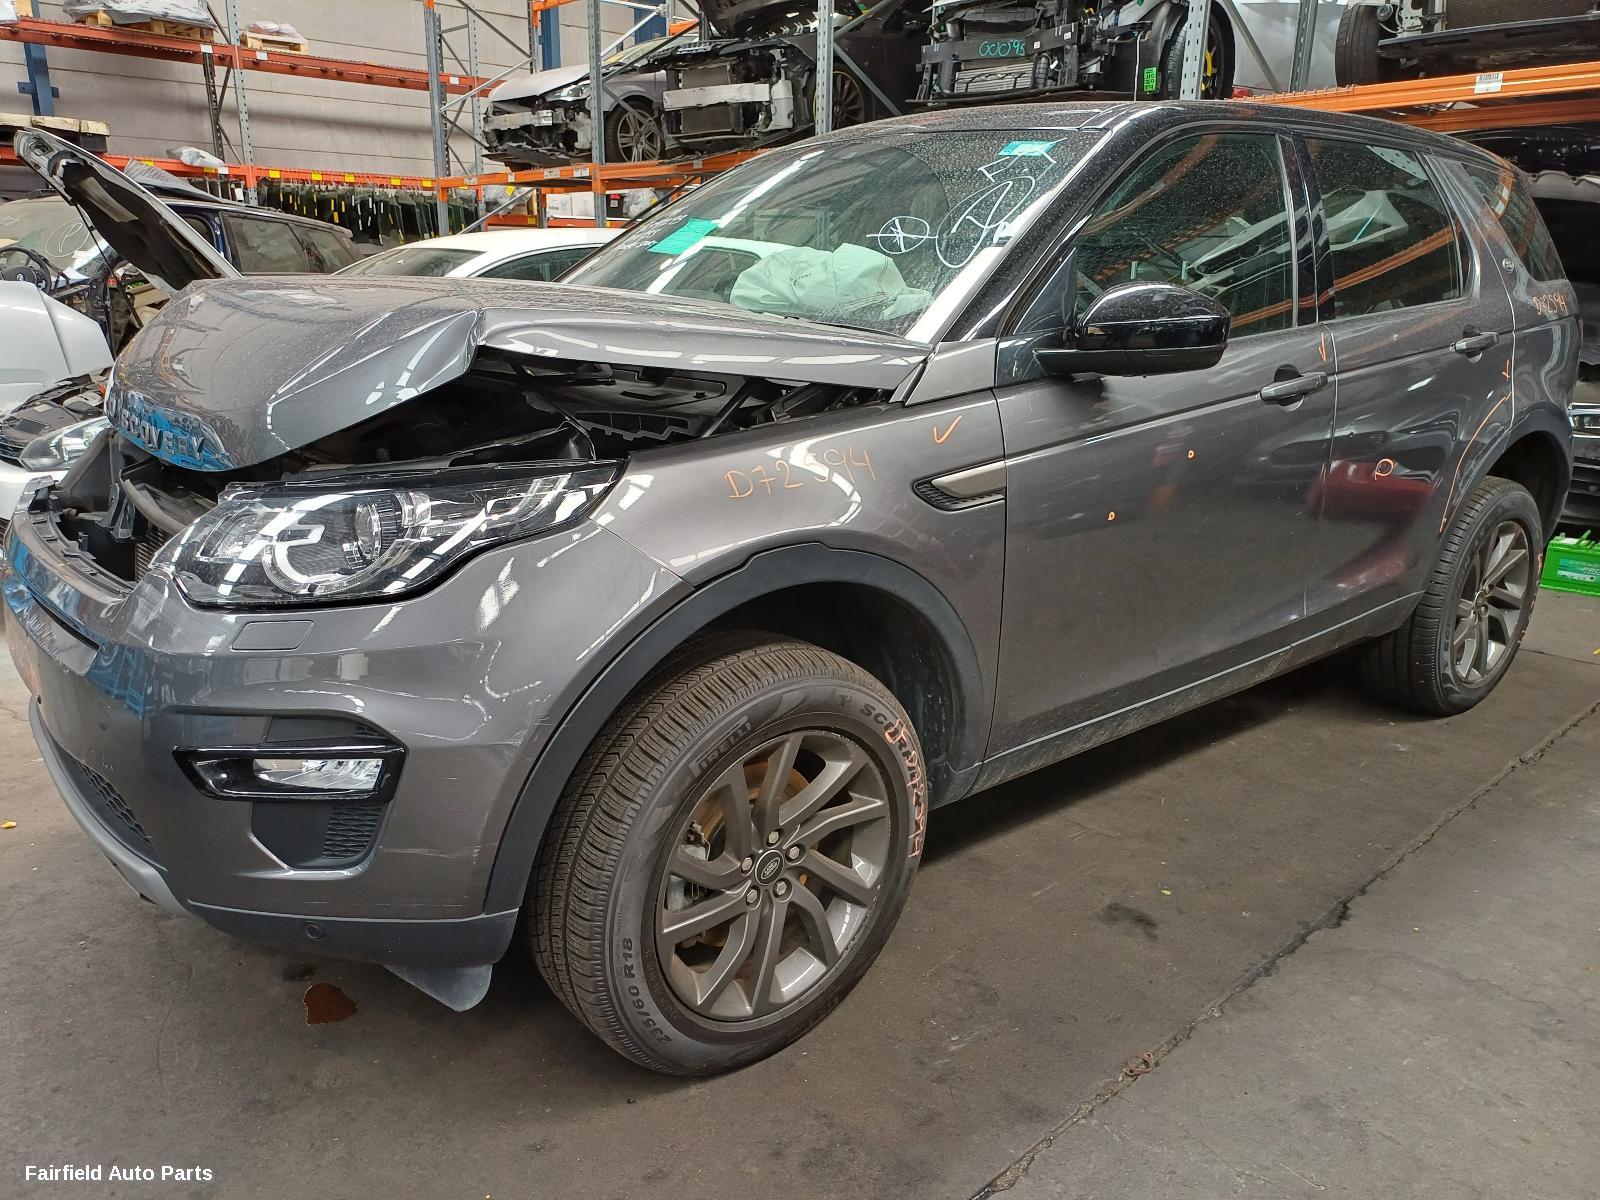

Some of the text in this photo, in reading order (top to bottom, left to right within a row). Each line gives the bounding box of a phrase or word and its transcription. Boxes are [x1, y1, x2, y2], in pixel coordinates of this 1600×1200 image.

[108, 387, 206, 462] DISCOVERY
[724, 445, 876, 498] D72594
[688, 716, 752, 778] PIRELLI
[622, 936, 636, 979] R18
[627, 985, 673, 1042] 235/60
